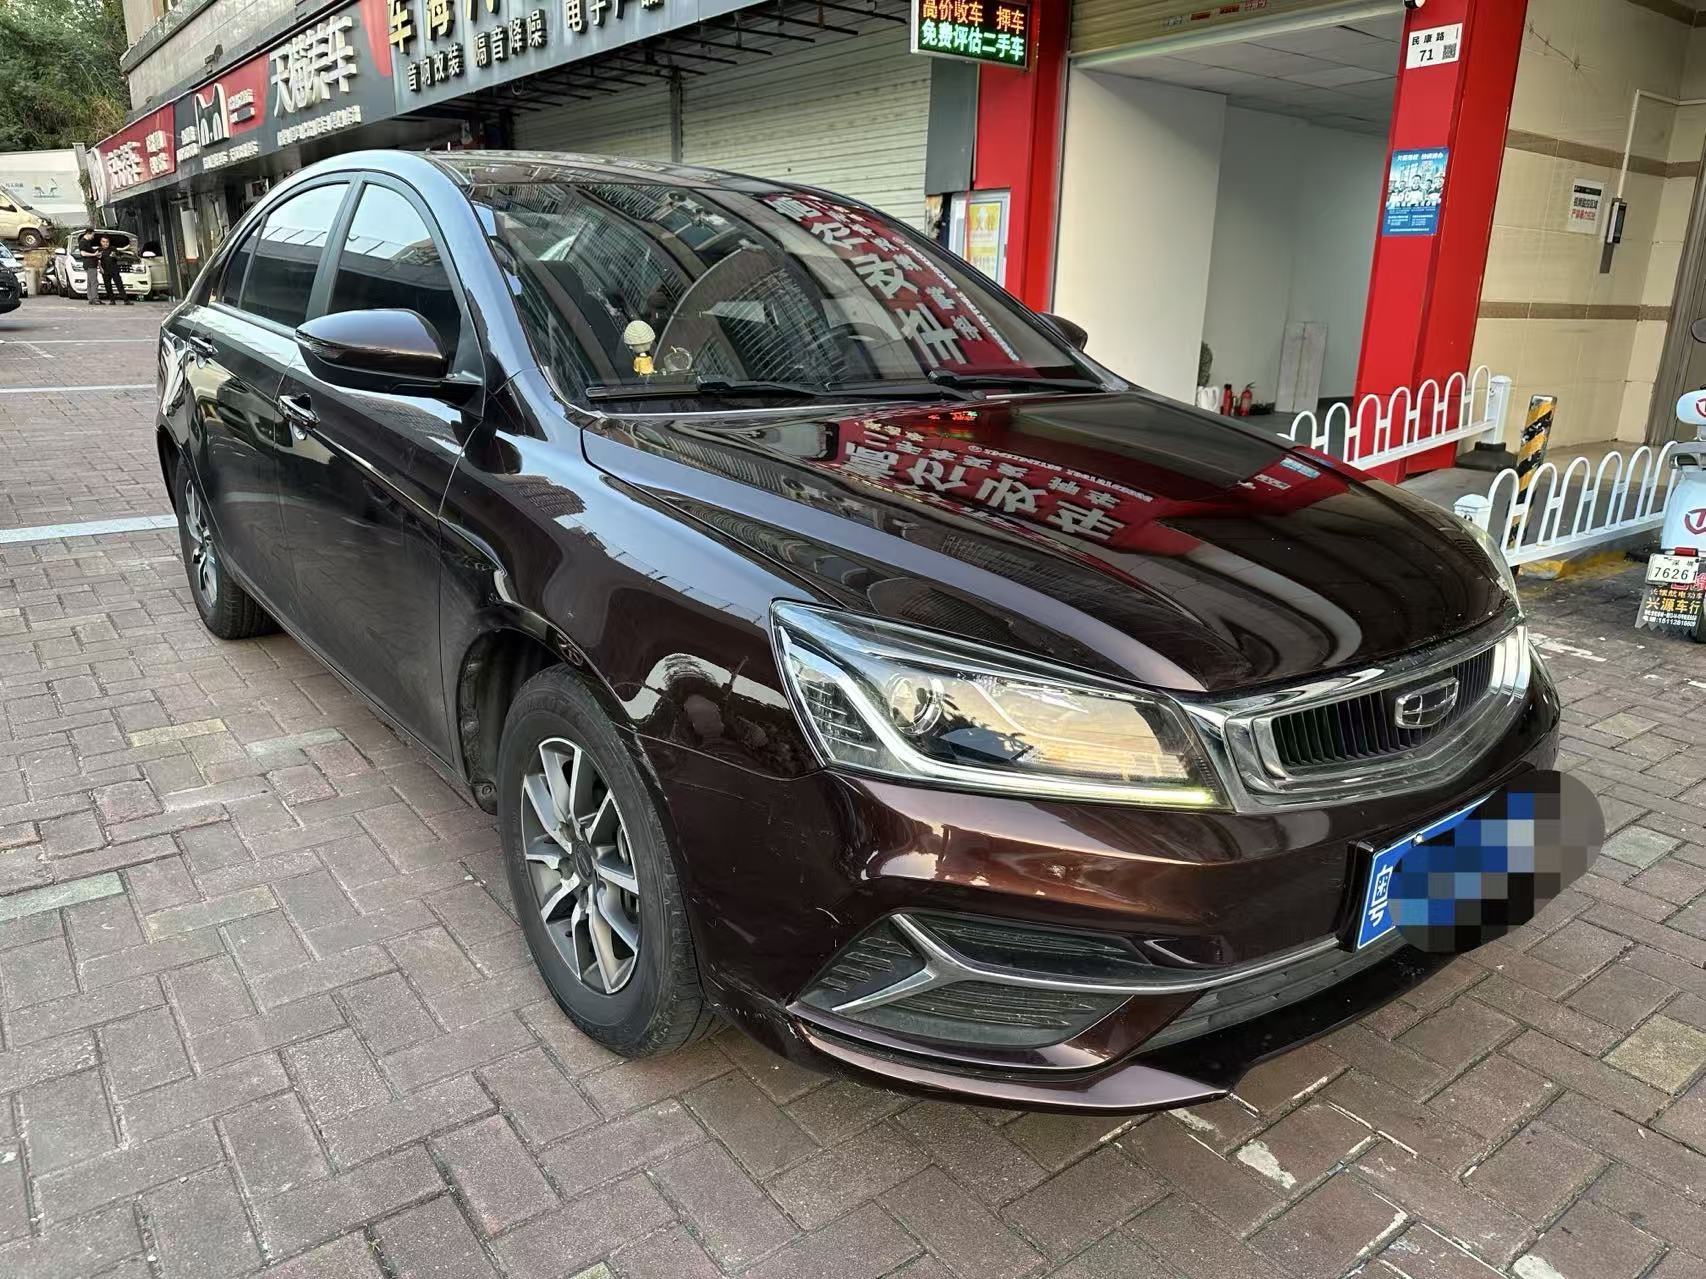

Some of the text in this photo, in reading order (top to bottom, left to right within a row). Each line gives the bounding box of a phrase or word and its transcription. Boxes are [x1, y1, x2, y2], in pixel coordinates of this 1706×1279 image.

[922, 0, 984, 27] 高价收车
[474, 9, 546, 67] 隔音降噪
[921, 18, 1025, 61] 免费评估二手车
[1411, 32, 1445, 46] 民康路
[1419, 49, 1434, 62] 71
[1645, 596, 1701, 615] 兴源车行
[1368, 864, 1394, 927] 粤
